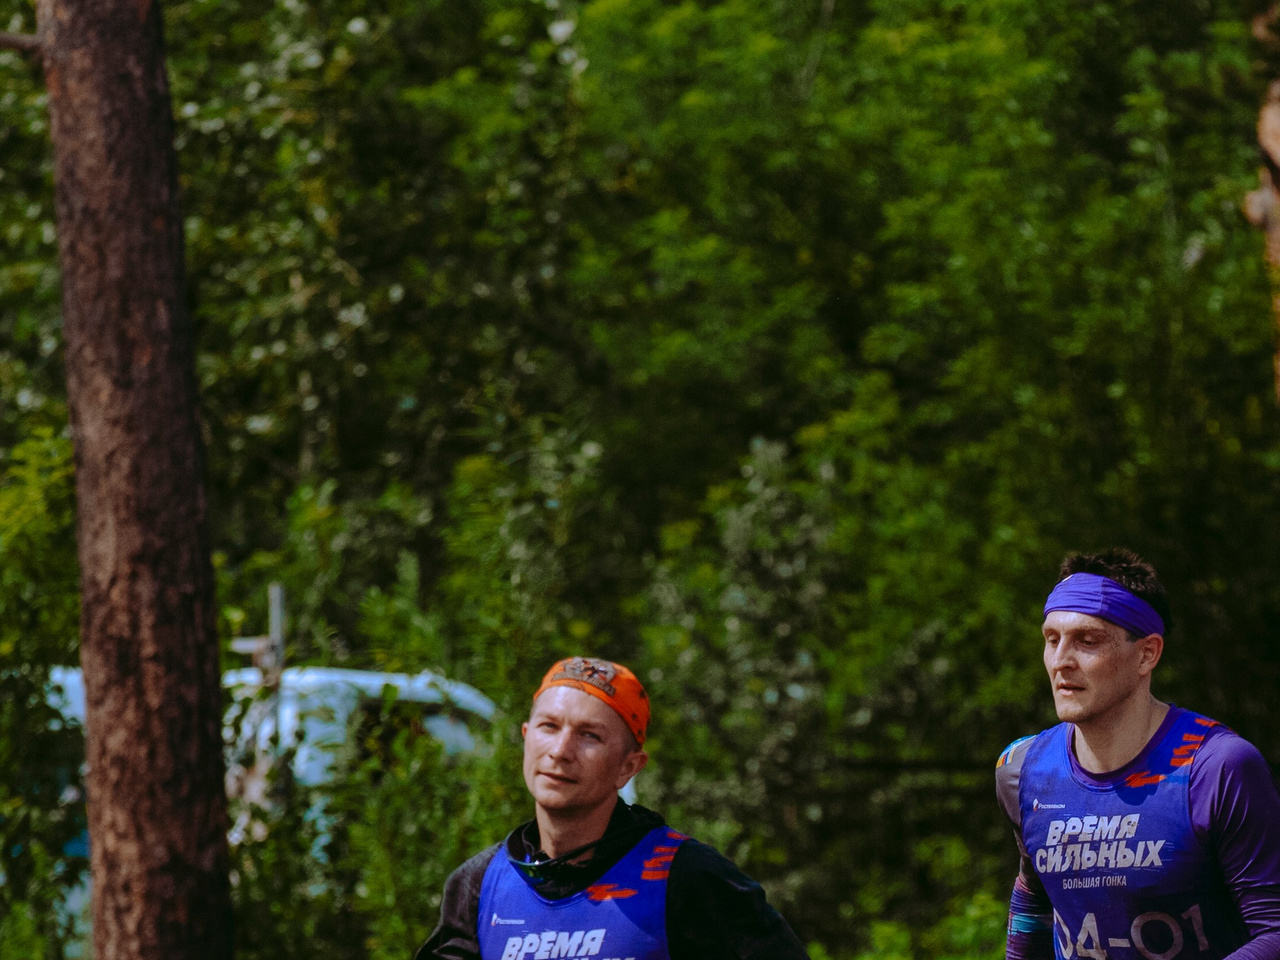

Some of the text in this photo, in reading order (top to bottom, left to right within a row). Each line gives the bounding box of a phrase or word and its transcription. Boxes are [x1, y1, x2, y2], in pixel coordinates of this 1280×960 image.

[1046, 814, 1140, 846] ВРЕМЯ
[1036, 840, 1166, 873] СИЛЬНЫХ
[1062, 875, 1127, 890] БОЛЬШАЯ ГОНКА
